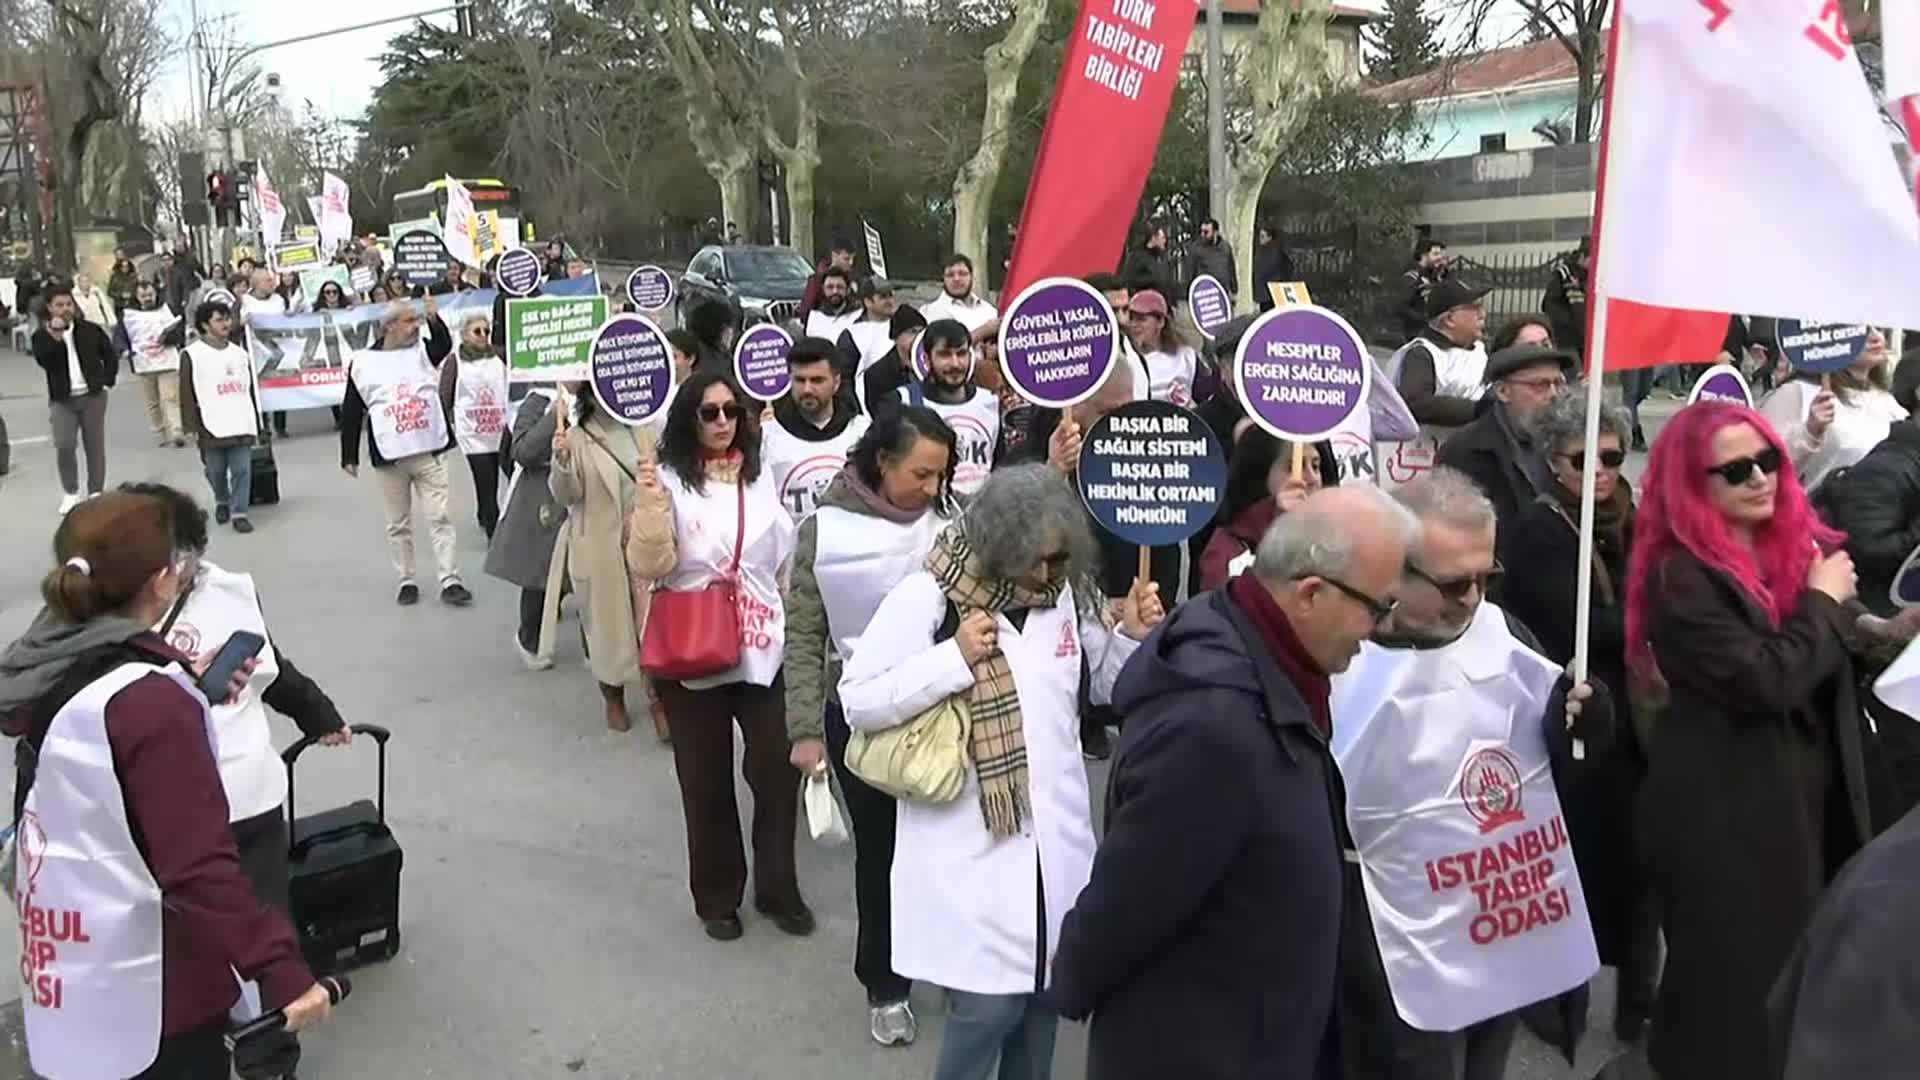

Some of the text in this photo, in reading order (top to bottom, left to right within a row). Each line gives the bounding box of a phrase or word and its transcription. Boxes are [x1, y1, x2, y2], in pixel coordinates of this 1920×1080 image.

[1086, 15, 1164, 73] TABİPLERİ
[1084, 53, 1143, 101] BİRLİĞİ
[1012, 306, 1100, 331] GÜVENLİ, YASAL,
[1006, 323, 1111, 351] ERİŞİLEBİLİR KÜRTAJ
[1027, 344, 1092, 367] KADINLARIN
[1266, 341, 1342, 361] MESEM'LER
[1035, 362, 1090, 384] HAKKIDIR!
[1244, 362, 1362, 385] ERGEN SAĞLIĞINA
[1262, 384, 1346, 406] ZARARLIDIR!
[1109, 414, 1189, 435] BAŞKA BİR
[1093, 436, 1207, 456] SAĞLIK SİSTEMİ
[1111, 460, 1189, 480] BAŞKA BİR
[1087, 482, 1216, 502] HEKİMLİK ORTAMI
[1116, 505, 1187, 525] MÜMKÜN!
[1425, 816, 1567, 892] İSTANBUL
[1472, 858, 1554, 913] TABİP
[1470, 887, 1571, 945] ODASI
